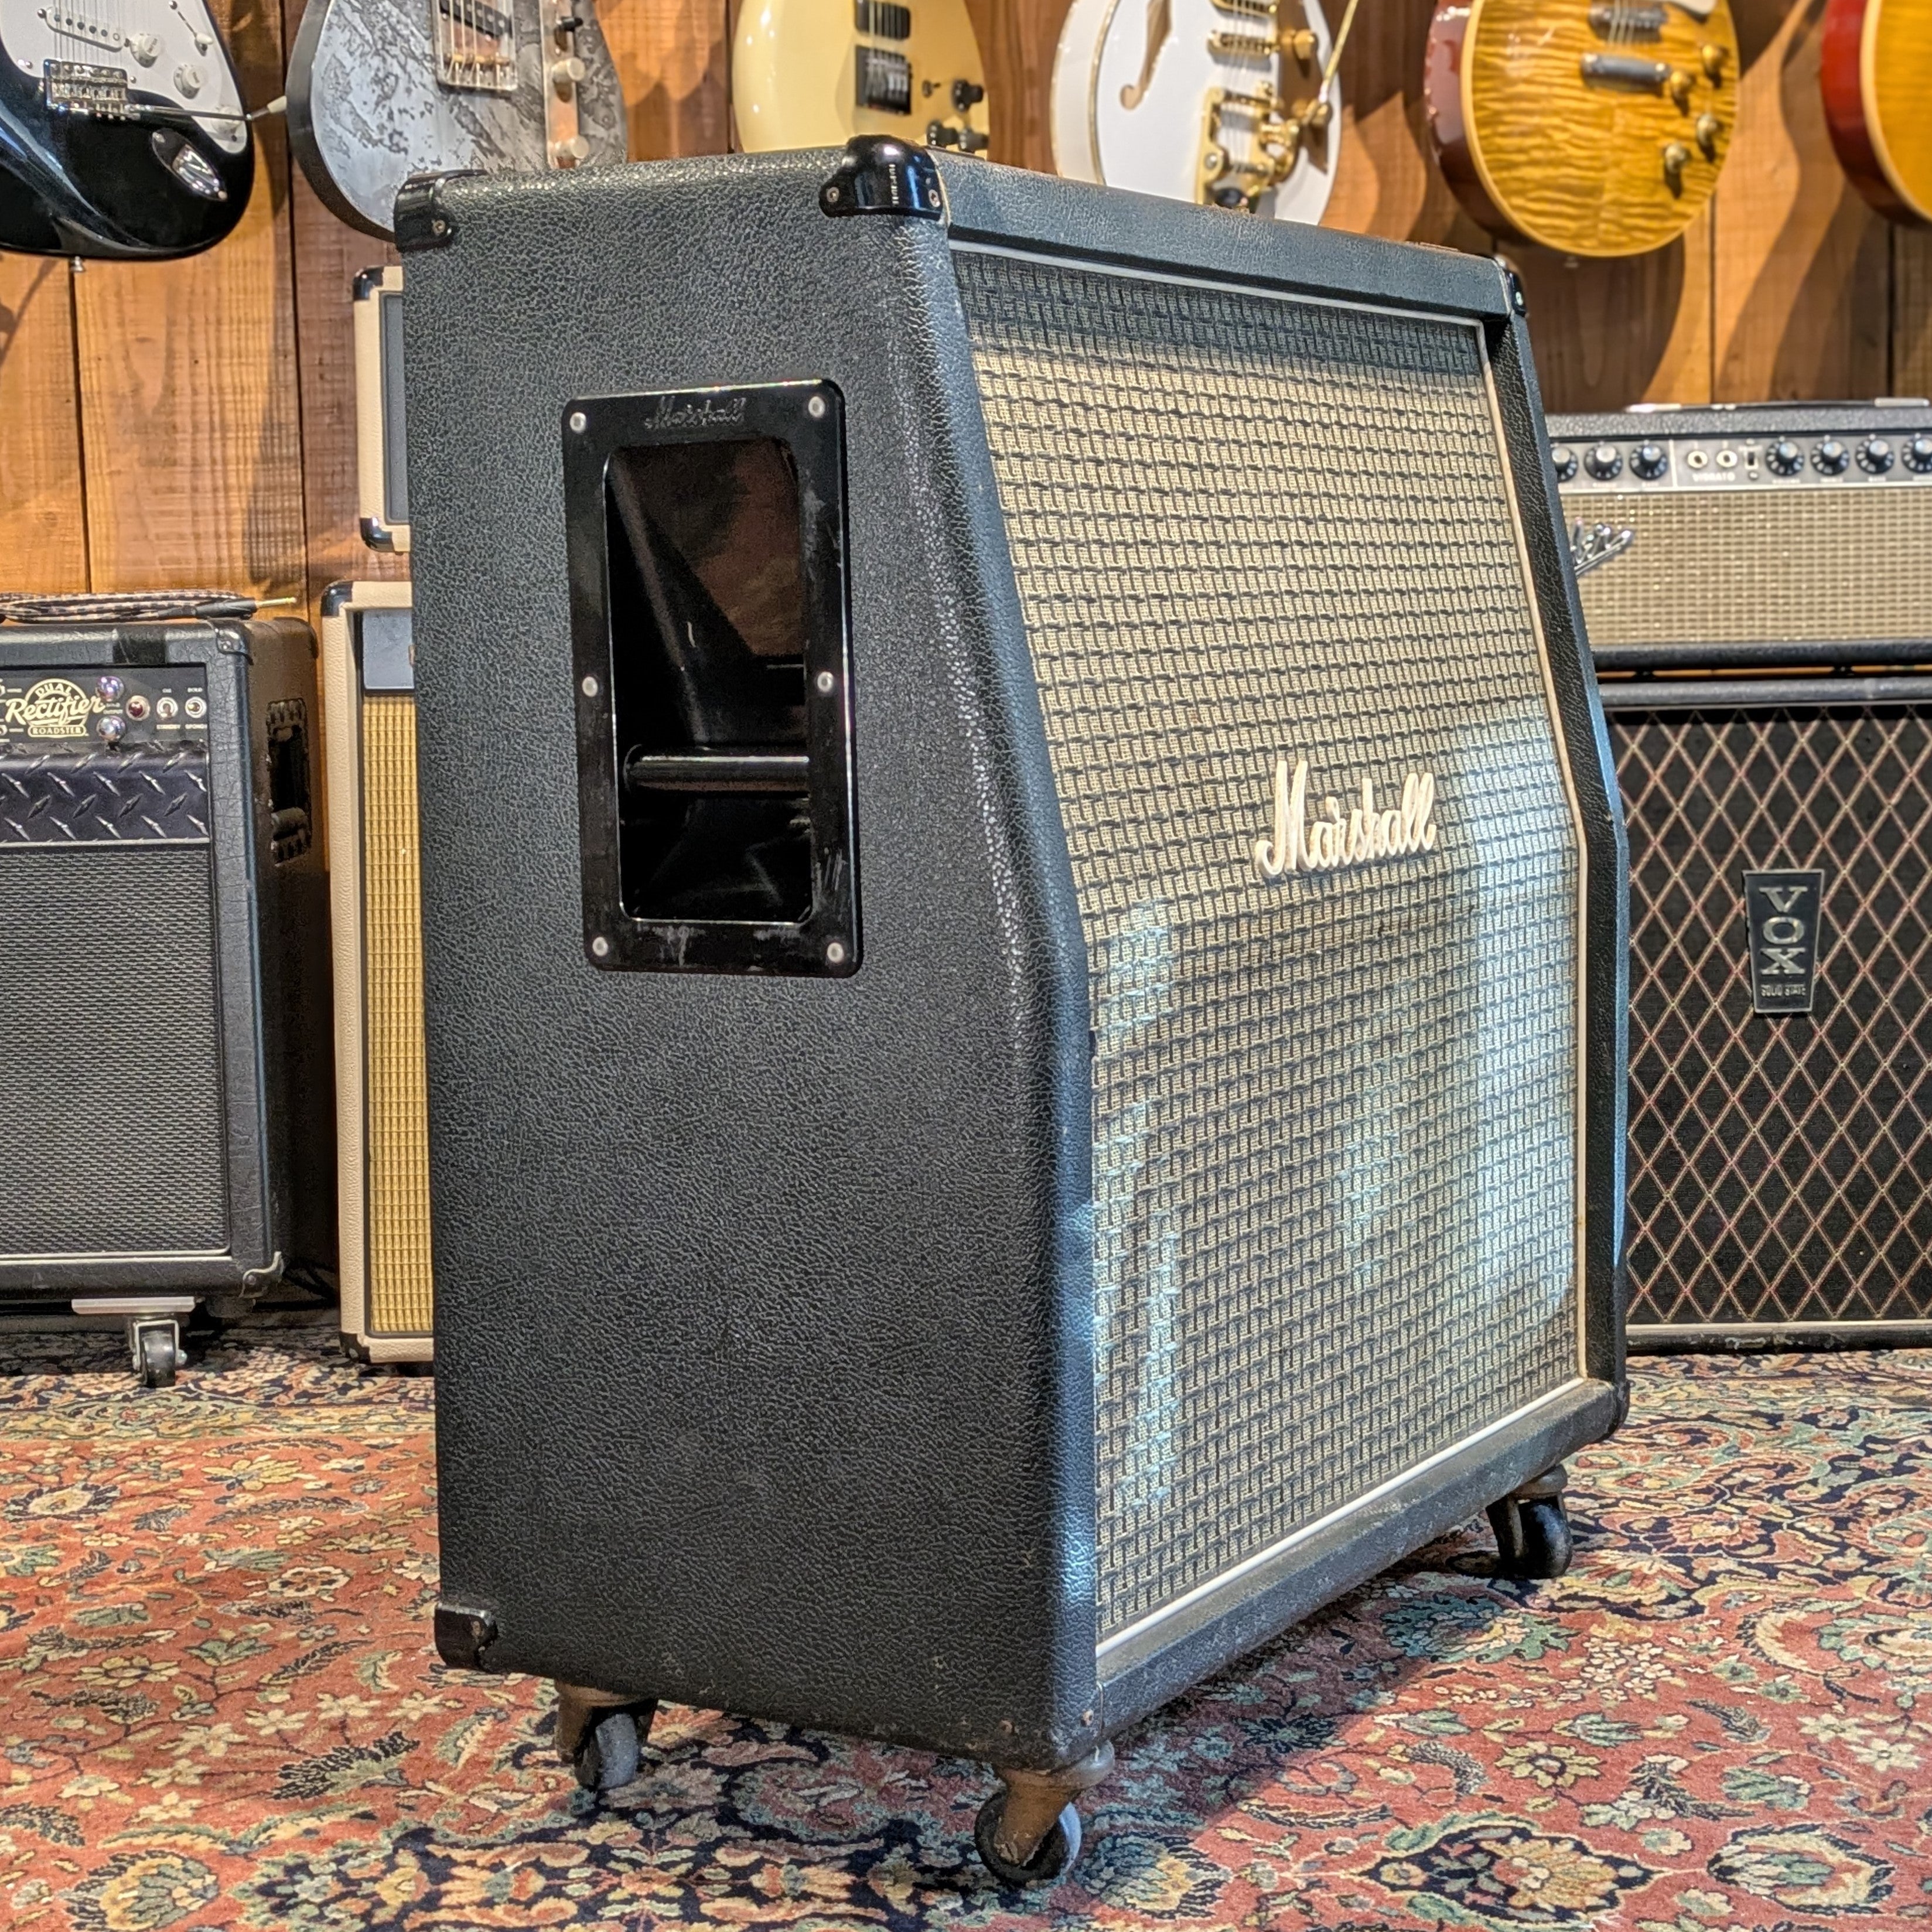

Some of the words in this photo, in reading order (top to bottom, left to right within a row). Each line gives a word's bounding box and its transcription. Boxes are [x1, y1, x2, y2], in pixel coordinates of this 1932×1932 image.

[5, 695, 106, 726] Rectifier
[35, 682, 73, 697] DUAL
[1255, 760, 1437, 877] Marshall
[1759, 885, 1808, 975] VOX
